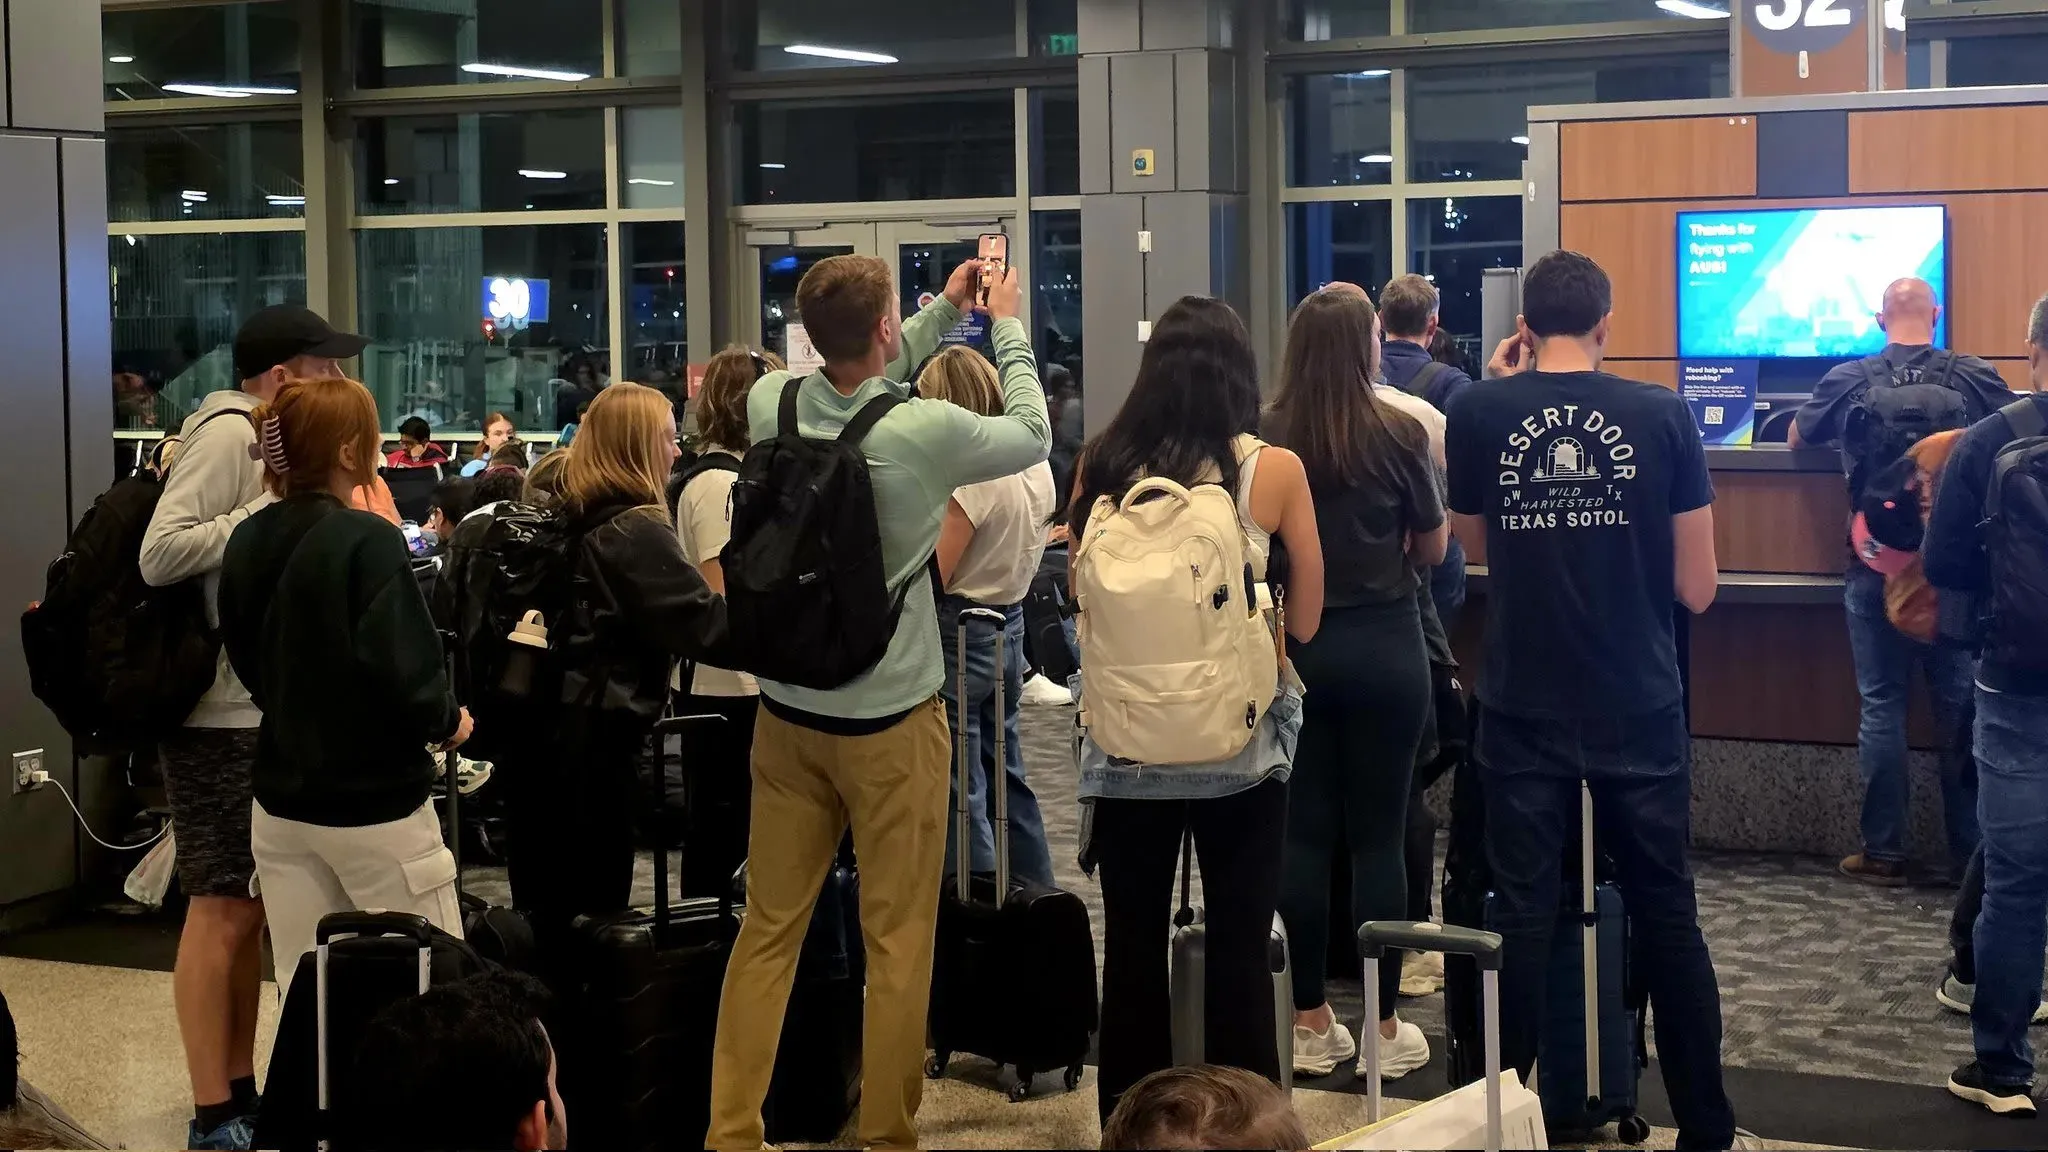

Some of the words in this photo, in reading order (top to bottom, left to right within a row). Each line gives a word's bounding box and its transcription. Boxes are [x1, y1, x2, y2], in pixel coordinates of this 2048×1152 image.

[1689, 223, 1736, 236] Thanks
[1737, 223, 1757, 235] for
[1689, 242, 1725, 258] flying
[1726, 242, 1754, 255] with
[488, 277, 530, 320] 30
[1499, 405, 1578, 486] DESERT
[1583, 410, 1636, 480] DOOR
[1548, 487, 1581, 497] WILD
[1520, 497, 1604, 510] HARVESTED
[1501, 513, 1557, 530] TEXAS
[1566, 509, 1629, 527] SOTOL
